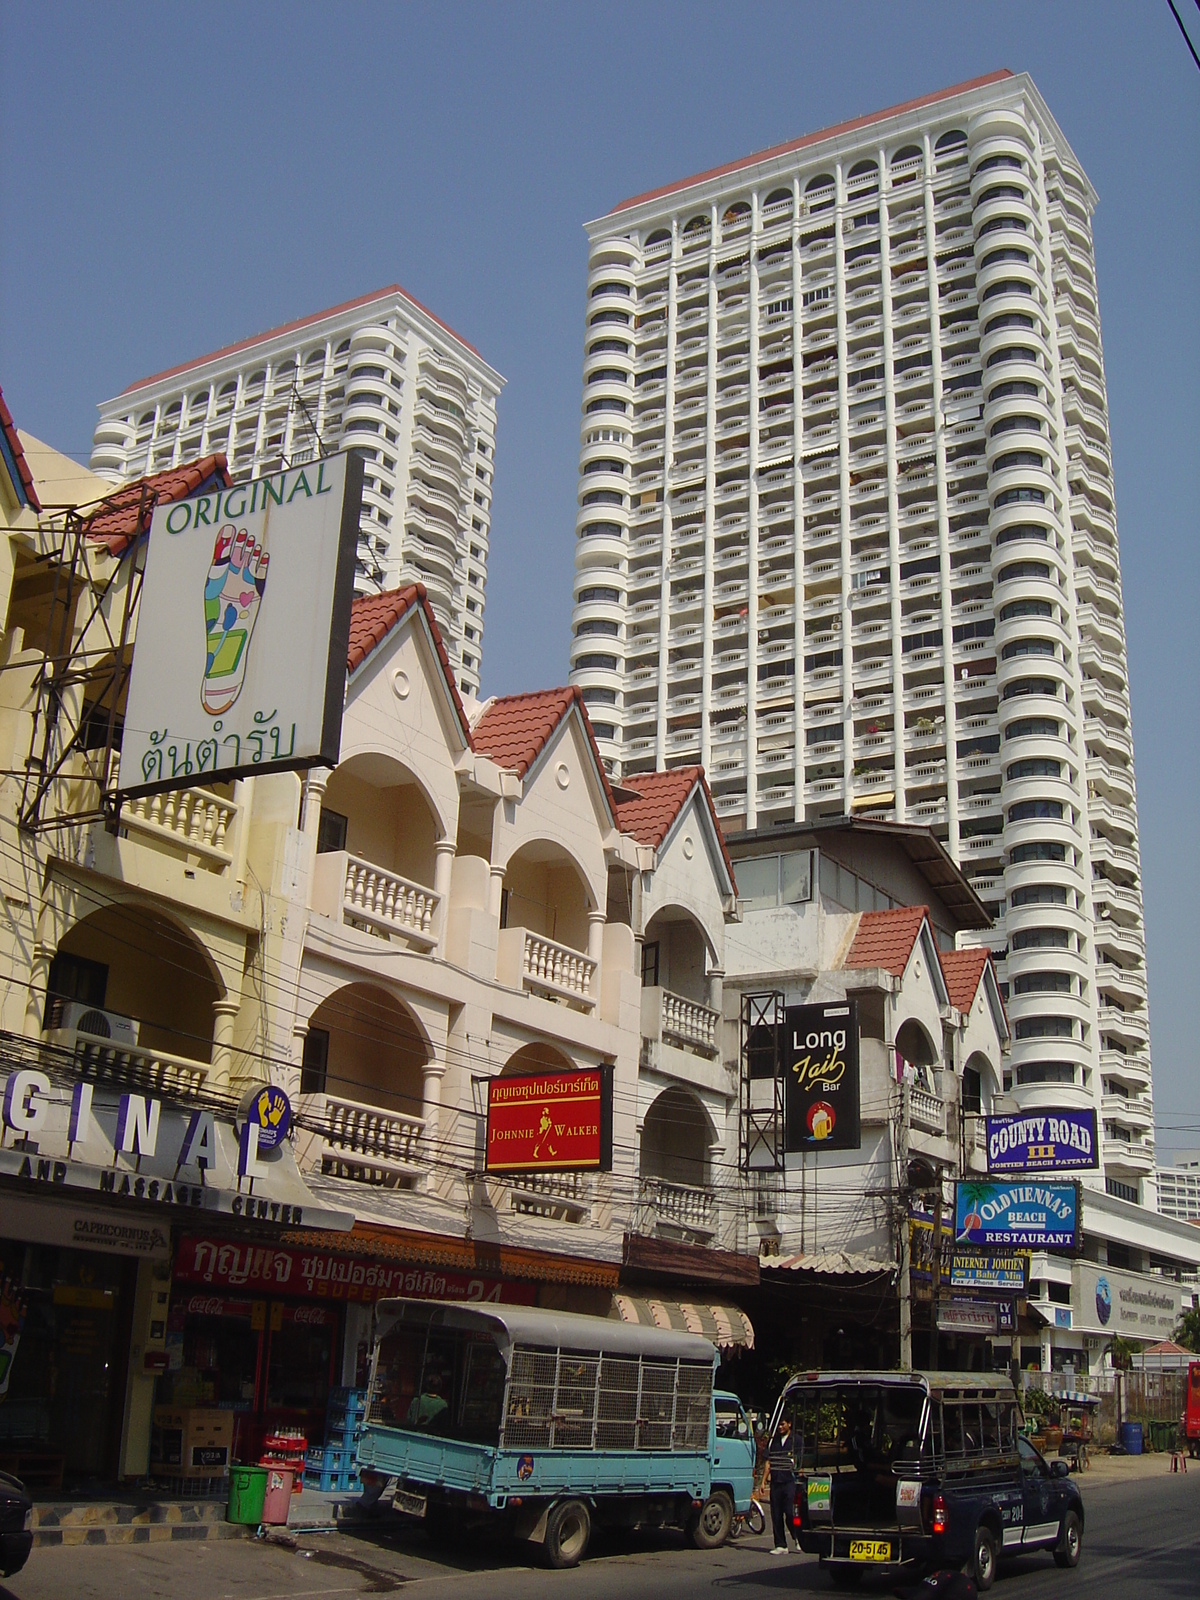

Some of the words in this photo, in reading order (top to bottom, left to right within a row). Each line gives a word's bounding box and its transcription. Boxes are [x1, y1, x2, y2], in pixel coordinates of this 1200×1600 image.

[166, 463, 332, 534] ORIGINAL
[142, 709, 295, 781] ต้นตำรับ
[793, 1030, 846, 1051] Long
[792, 1046, 846, 1083] Tail
[822, 1082, 841, 1092] Bar
[2, 1070, 269, 1178] GINAL
[490, 1128, 534, 1143] JOHNNIE
[554, 1124, 598, 1137] WALKER
[990, 1117, 1046, 1160] COUNTY
[1048, 1117, 1091, 1154] ROAD
[1027, 1144, 1056, 1159] III
[990, 1161, 1024, 1169] JOMTIEN
[1055, 1157, 1093, 1165] PATTAYA
[18, 1156, 67, 1184] AND
[99, 1170, 203, 1206] MASSAGE
[232, 1196, 303, 1225] CENTER
[980, 1193, 1011, 1220] OLD
[1009, 1187, 1072, 1219] VIENNA'S
[1007, 1212, 1047, 1222] BEACH
[74, 1220, 150, 1240] CAPRICORNUS
[985, 1232, 1073, 1244] RESTAURANT
[193, 1240, 293, 1284] กุญแจ
[953, 1256, 989, 1269] INTERNET
[991, 1258, 1024, 1271] JOMTIEN
[1004, 1271, 1021, 1280] Min
[851, 1542, 888, 1555] 20-5145
